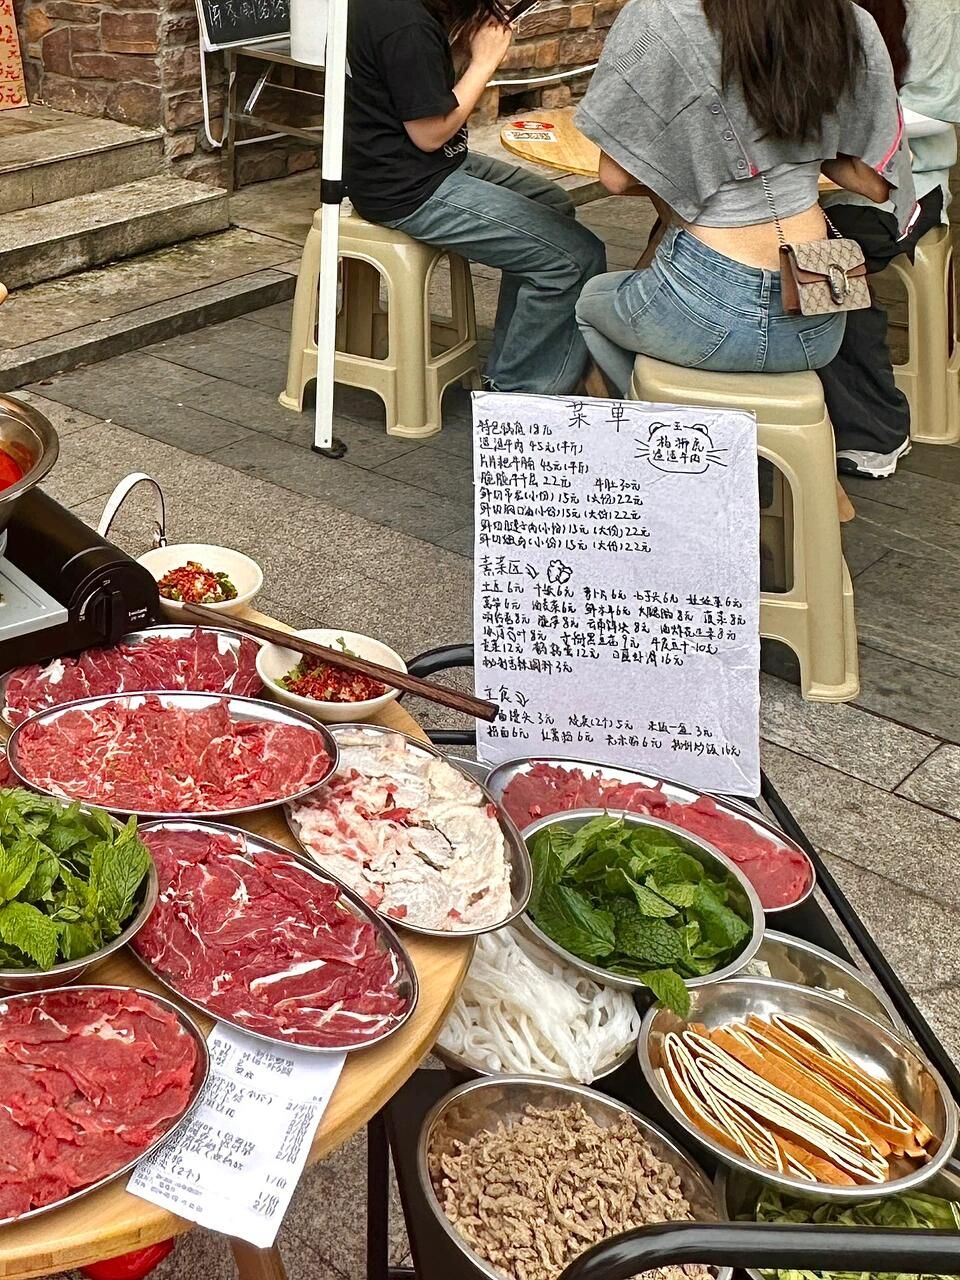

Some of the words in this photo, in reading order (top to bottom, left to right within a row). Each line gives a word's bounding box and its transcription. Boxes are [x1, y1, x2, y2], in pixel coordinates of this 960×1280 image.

[565, 402, 631, 433] 菜单
[479, 555, 523, 577] 素菜区
[484, 685, 512, 703] 主食
